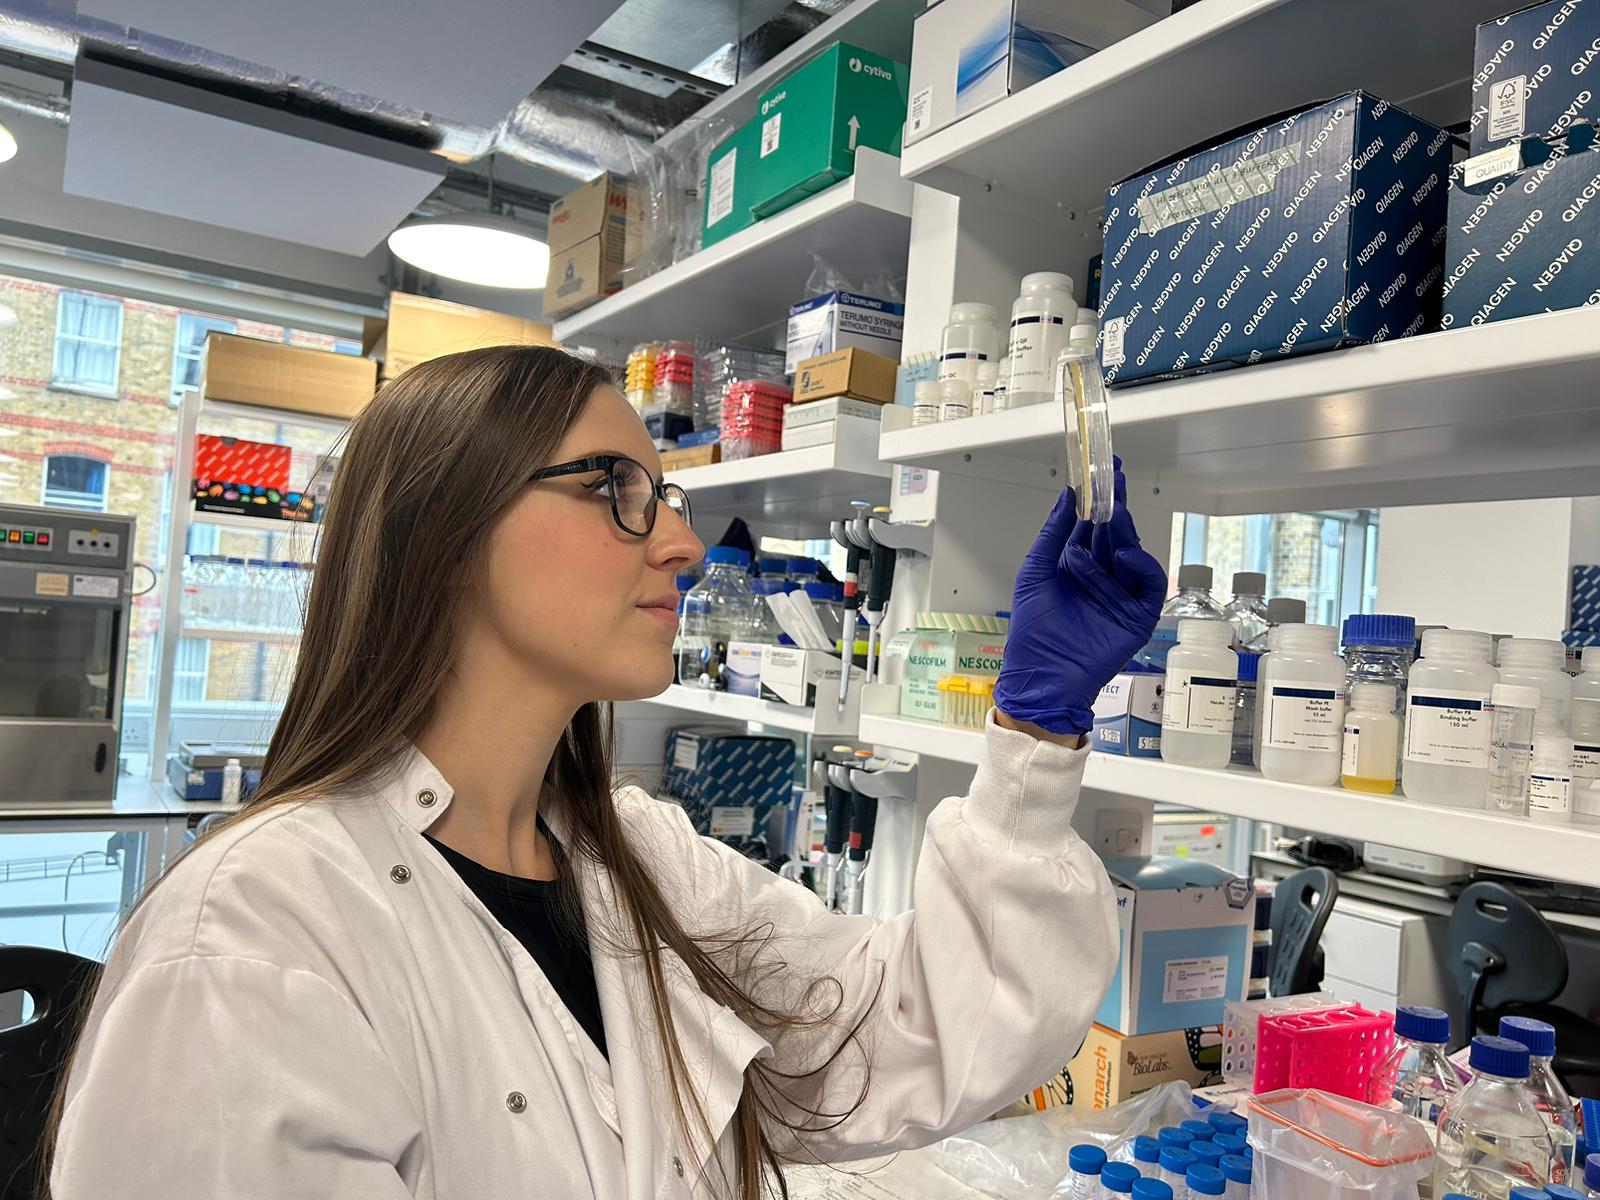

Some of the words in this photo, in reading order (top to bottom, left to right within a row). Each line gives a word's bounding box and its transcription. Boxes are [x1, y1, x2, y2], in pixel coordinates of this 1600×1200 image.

[1532, 0, 1582, 50] QIAGEN
[863, 64, 892, 81] cytiva
[1472, 39, 1515, 93] QIAGEN
[1232, 128, 1268, 172] QIAGEN
[1305, 108, 1345, 158] QIAGEN
[1353, 136, 1385, 171] QIAGEN
[1391, 131, 1419, 164] QIAGEN
[1426, 129, 1450, 157] QIAGEN
[1411, 173, 1438, 206] QIAGEN
[1475, 158, 1515, 179] QUALITY
[1284, 170, 1322, 218] QIAGEN
[1376, 179, 1405, 214] QIAGEN
[1461, 181, 1506, 234] QIAGEN
[1169, 217, 1201, 260] QIAGEN
[1235, 207, 1271, 253] QIAGEN
[1312, 194, 1351, 244] QIAGEN
[1396, 221, 1424, 256] QIAGEN
[1495, 209, 1543, 262] QIAGEN
[1111, 228, 1139, 268] QIAGEN
[1192, 241, 1225, 284] QIAGEN
[1261, 231, 1299, 278] QIAGEN
[1356, 230, 1387, 266] QIAGEN
[1533, 238, 1583, 293] QIAGEN
[1130, 249, 1160, 290] QIAGEN
[1217, 265, 1251, 309] QIAGEN
[1290, 257, 1328, 305] QIAGEN
[1378, 272, 1407, 308] QIAGEN
[1442, 247, 1482, 299] QIAGEN
[850, 297, 882, 309] TERUMO
[1097, 278, 1123, 319] QIAGEN
[1151, 272, 1182, 314] QIAGEN
[1243, 290, 1279, 336] QIAGEN
[1470, 276, 1518, 326] QIAGEN
[841, 310, 873, 324] TERUMO
[841, 320, 868, 331] WITHOUT
[869, 325, 892, 335] NEEDLE
[1174, 296, 1206, 339] QIAGEN
[1136, 325, 1166, 366] QIAGEN
[1200, 322, 1232, 364] QIAGEN
[909, 655, 946, 668] NESCOFILM
[959, 656, 1004, 670] NESCOF
[1133, 1058, 1169, 1076] BioLabs
